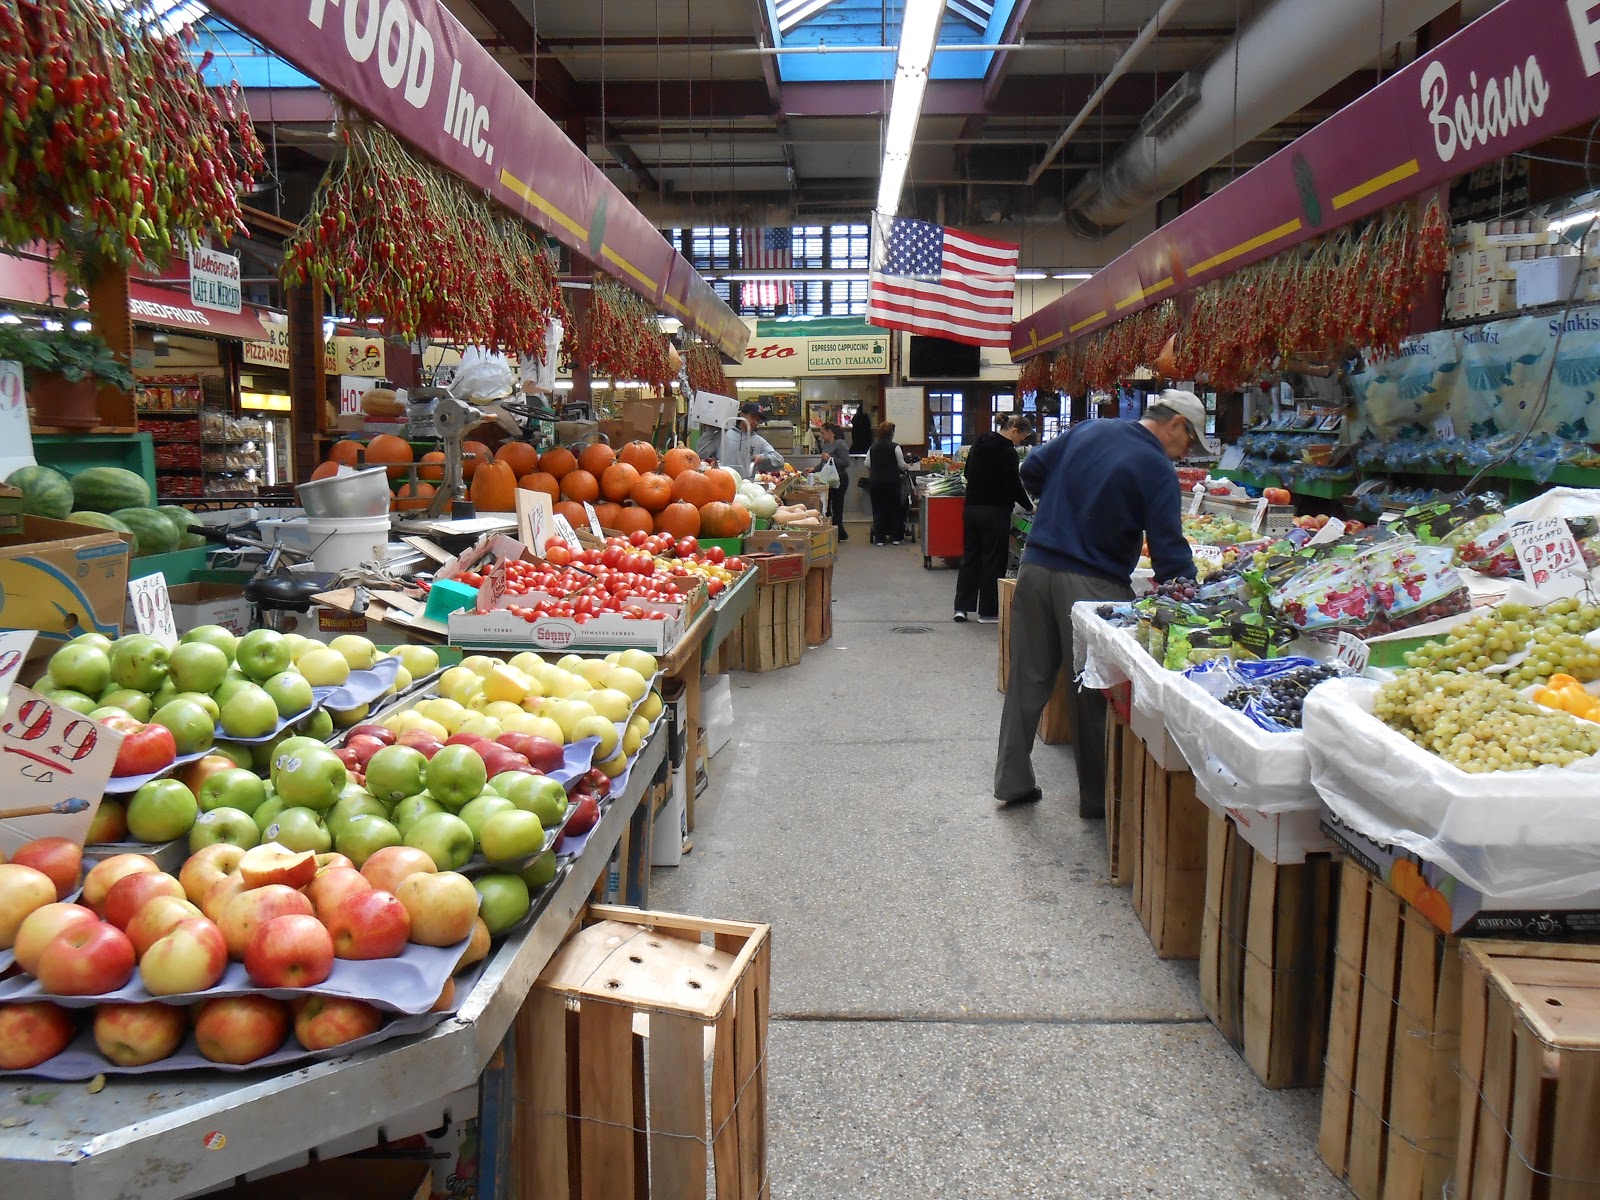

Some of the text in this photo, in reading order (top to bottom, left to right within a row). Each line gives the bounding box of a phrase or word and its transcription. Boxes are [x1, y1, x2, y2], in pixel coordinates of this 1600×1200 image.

[444, 59, 494, 166] Inc.
[1420, 55, 1549, 162] Boiano
[194, 252, 229, 278] Welcome
[1549, 312, 1600, 337] Sunkis
[1463, 329, 1500, 346] Sunkist
[325, 341, 336, 356] ES
[744, 344, 798, 359] ato
[811, 342, 869, 352] ESPRESSO CAPPUCCINO
[1397, 341, 1430, 360] unkist
[809, 356, 883, 366] GELATO ITALIANO
[1511, 517, 1558, 539] ITALIA
[320, 616, 366, 628] COLUMBINE
